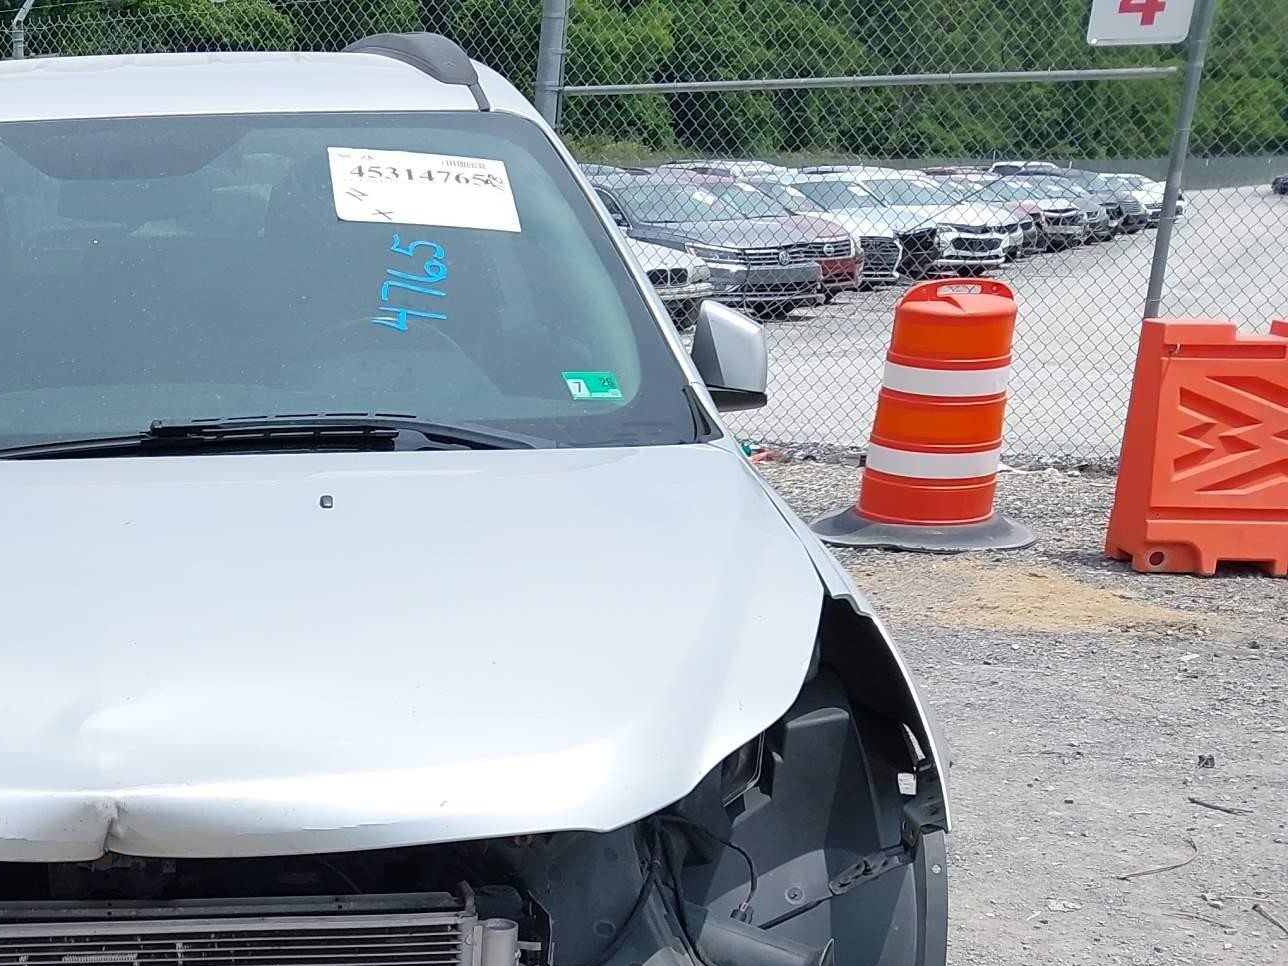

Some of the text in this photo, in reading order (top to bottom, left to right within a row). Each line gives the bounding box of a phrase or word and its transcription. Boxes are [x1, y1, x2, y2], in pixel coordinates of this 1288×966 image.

[350, 165, 488, 187] 45314765
[371, 233, 448, 331] 4765
[572, 381, 581, 393] 7
